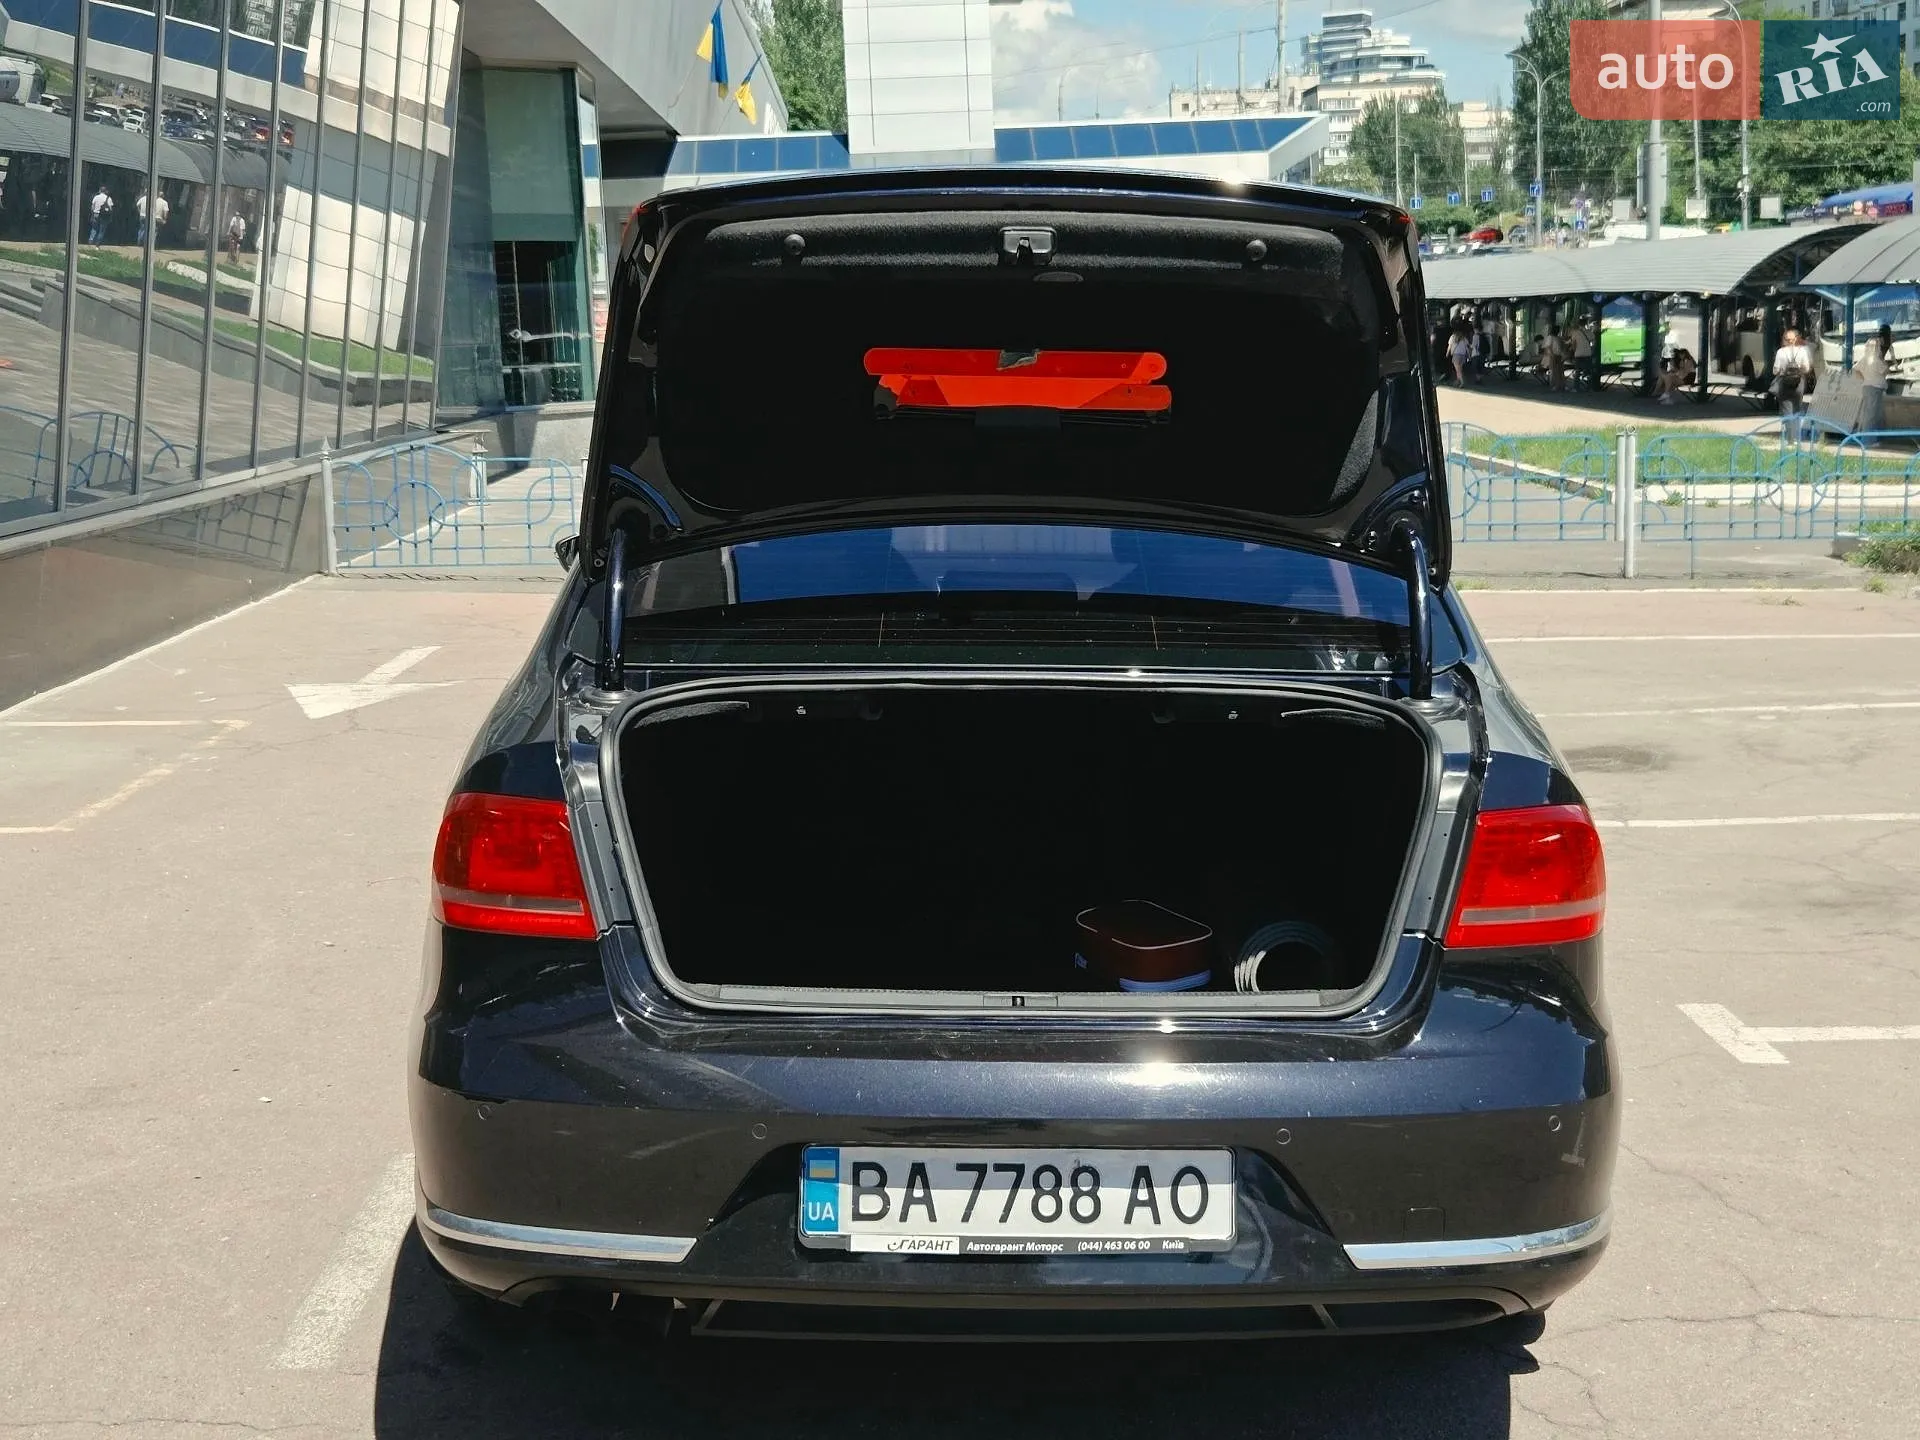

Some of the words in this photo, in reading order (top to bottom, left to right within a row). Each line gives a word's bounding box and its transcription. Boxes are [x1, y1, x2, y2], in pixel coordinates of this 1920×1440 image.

[850, 1160, 938, 1223] BA
[955, 1162, 1102, 1225] 7788
[808, 1201, 836, 1222] UA
[900, 1239, 953, 1251] ГАРАНТ
[966, 1241, 1025, 1254] Автогарант
[1025, 1241, 1063, 1254] Моторс
[1077, 1240, 1102, 1252] (044)
[1104, 1240, 1122, 1251] 463
[1123, 1240, 1136, 1250] 06
[1138, 1240, 1150, 1250] 00
[1162, 1239, 1185, 1250] Київ
